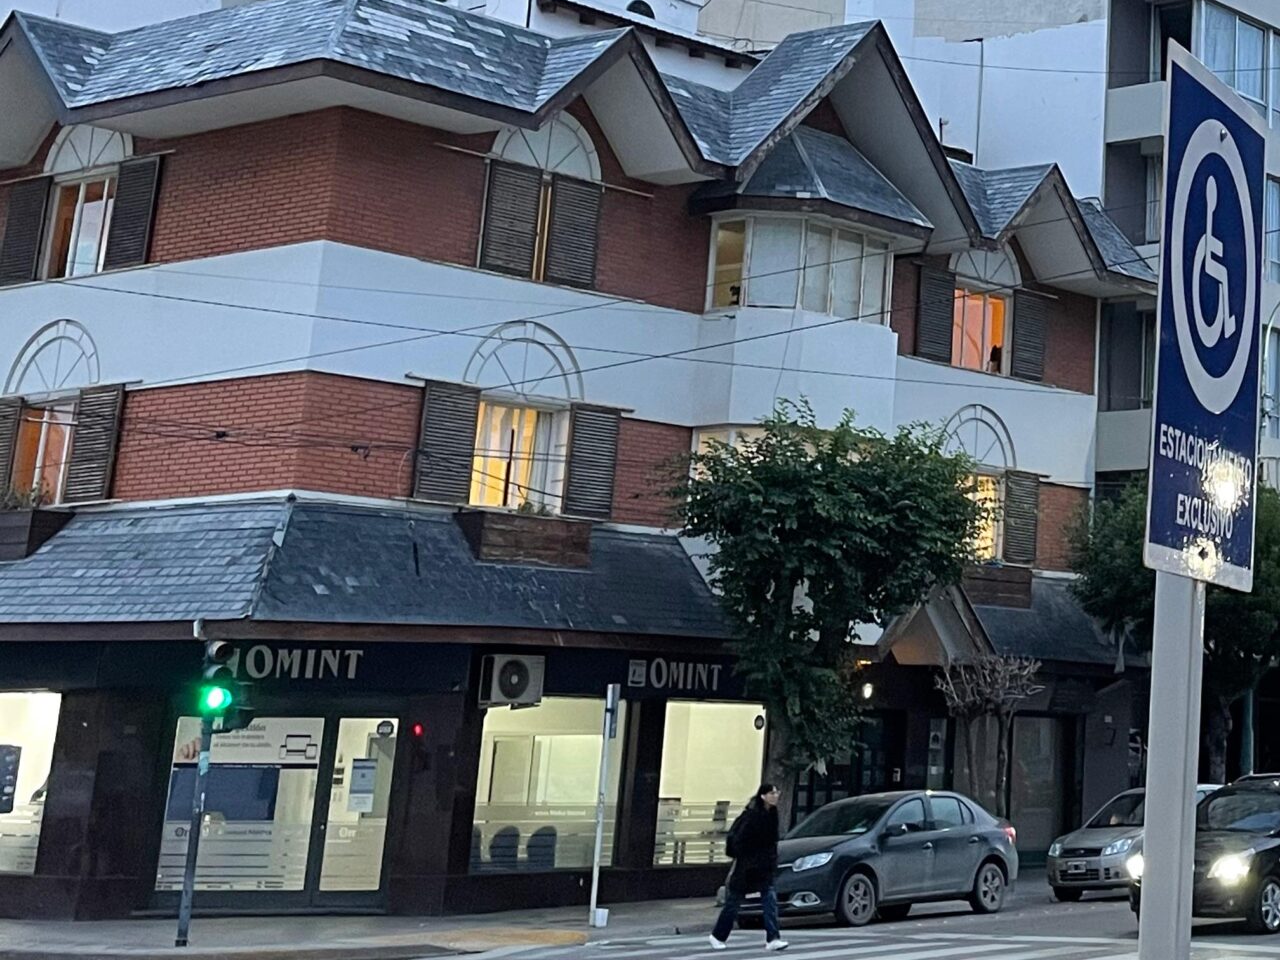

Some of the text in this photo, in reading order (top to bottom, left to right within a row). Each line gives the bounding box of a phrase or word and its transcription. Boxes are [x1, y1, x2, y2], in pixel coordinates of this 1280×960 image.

[1176, 493, 1233, 539] EXCLUSIVO
[246, 644, 363, 680] OMINT
[650, 657, 722, 691] OMINT
